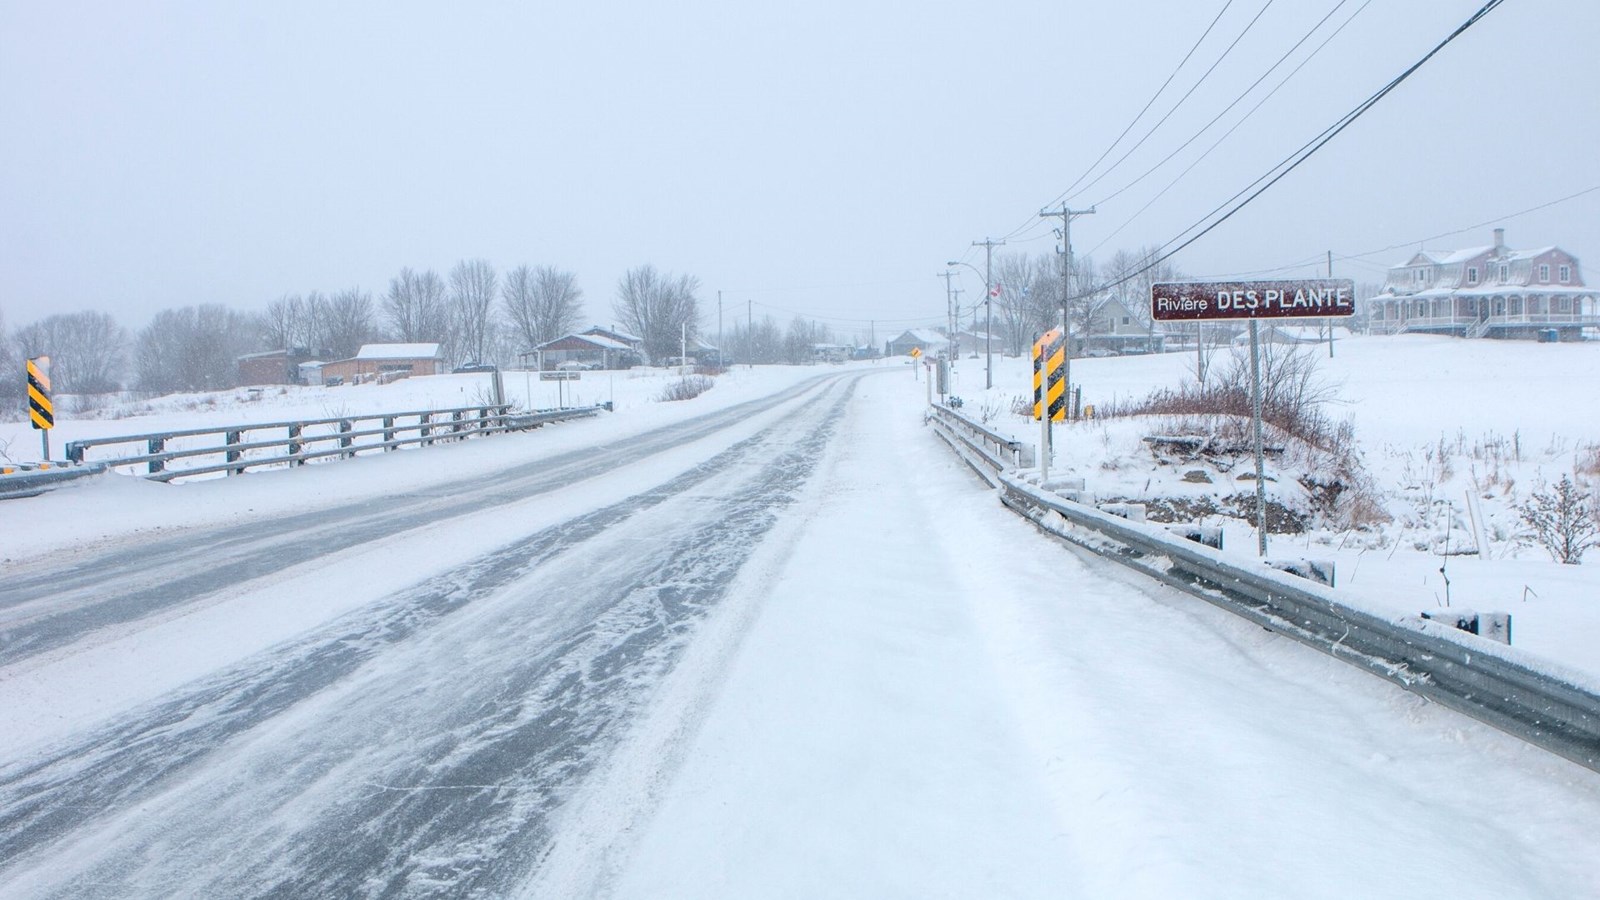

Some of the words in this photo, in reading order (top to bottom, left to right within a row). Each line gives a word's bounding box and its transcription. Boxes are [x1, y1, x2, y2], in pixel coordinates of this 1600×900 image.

[1158, 297, 1208, 311] Rivière
[1217, 291, 1259, 309] DES
[1265, 287, 1350, 308] PLANTE
